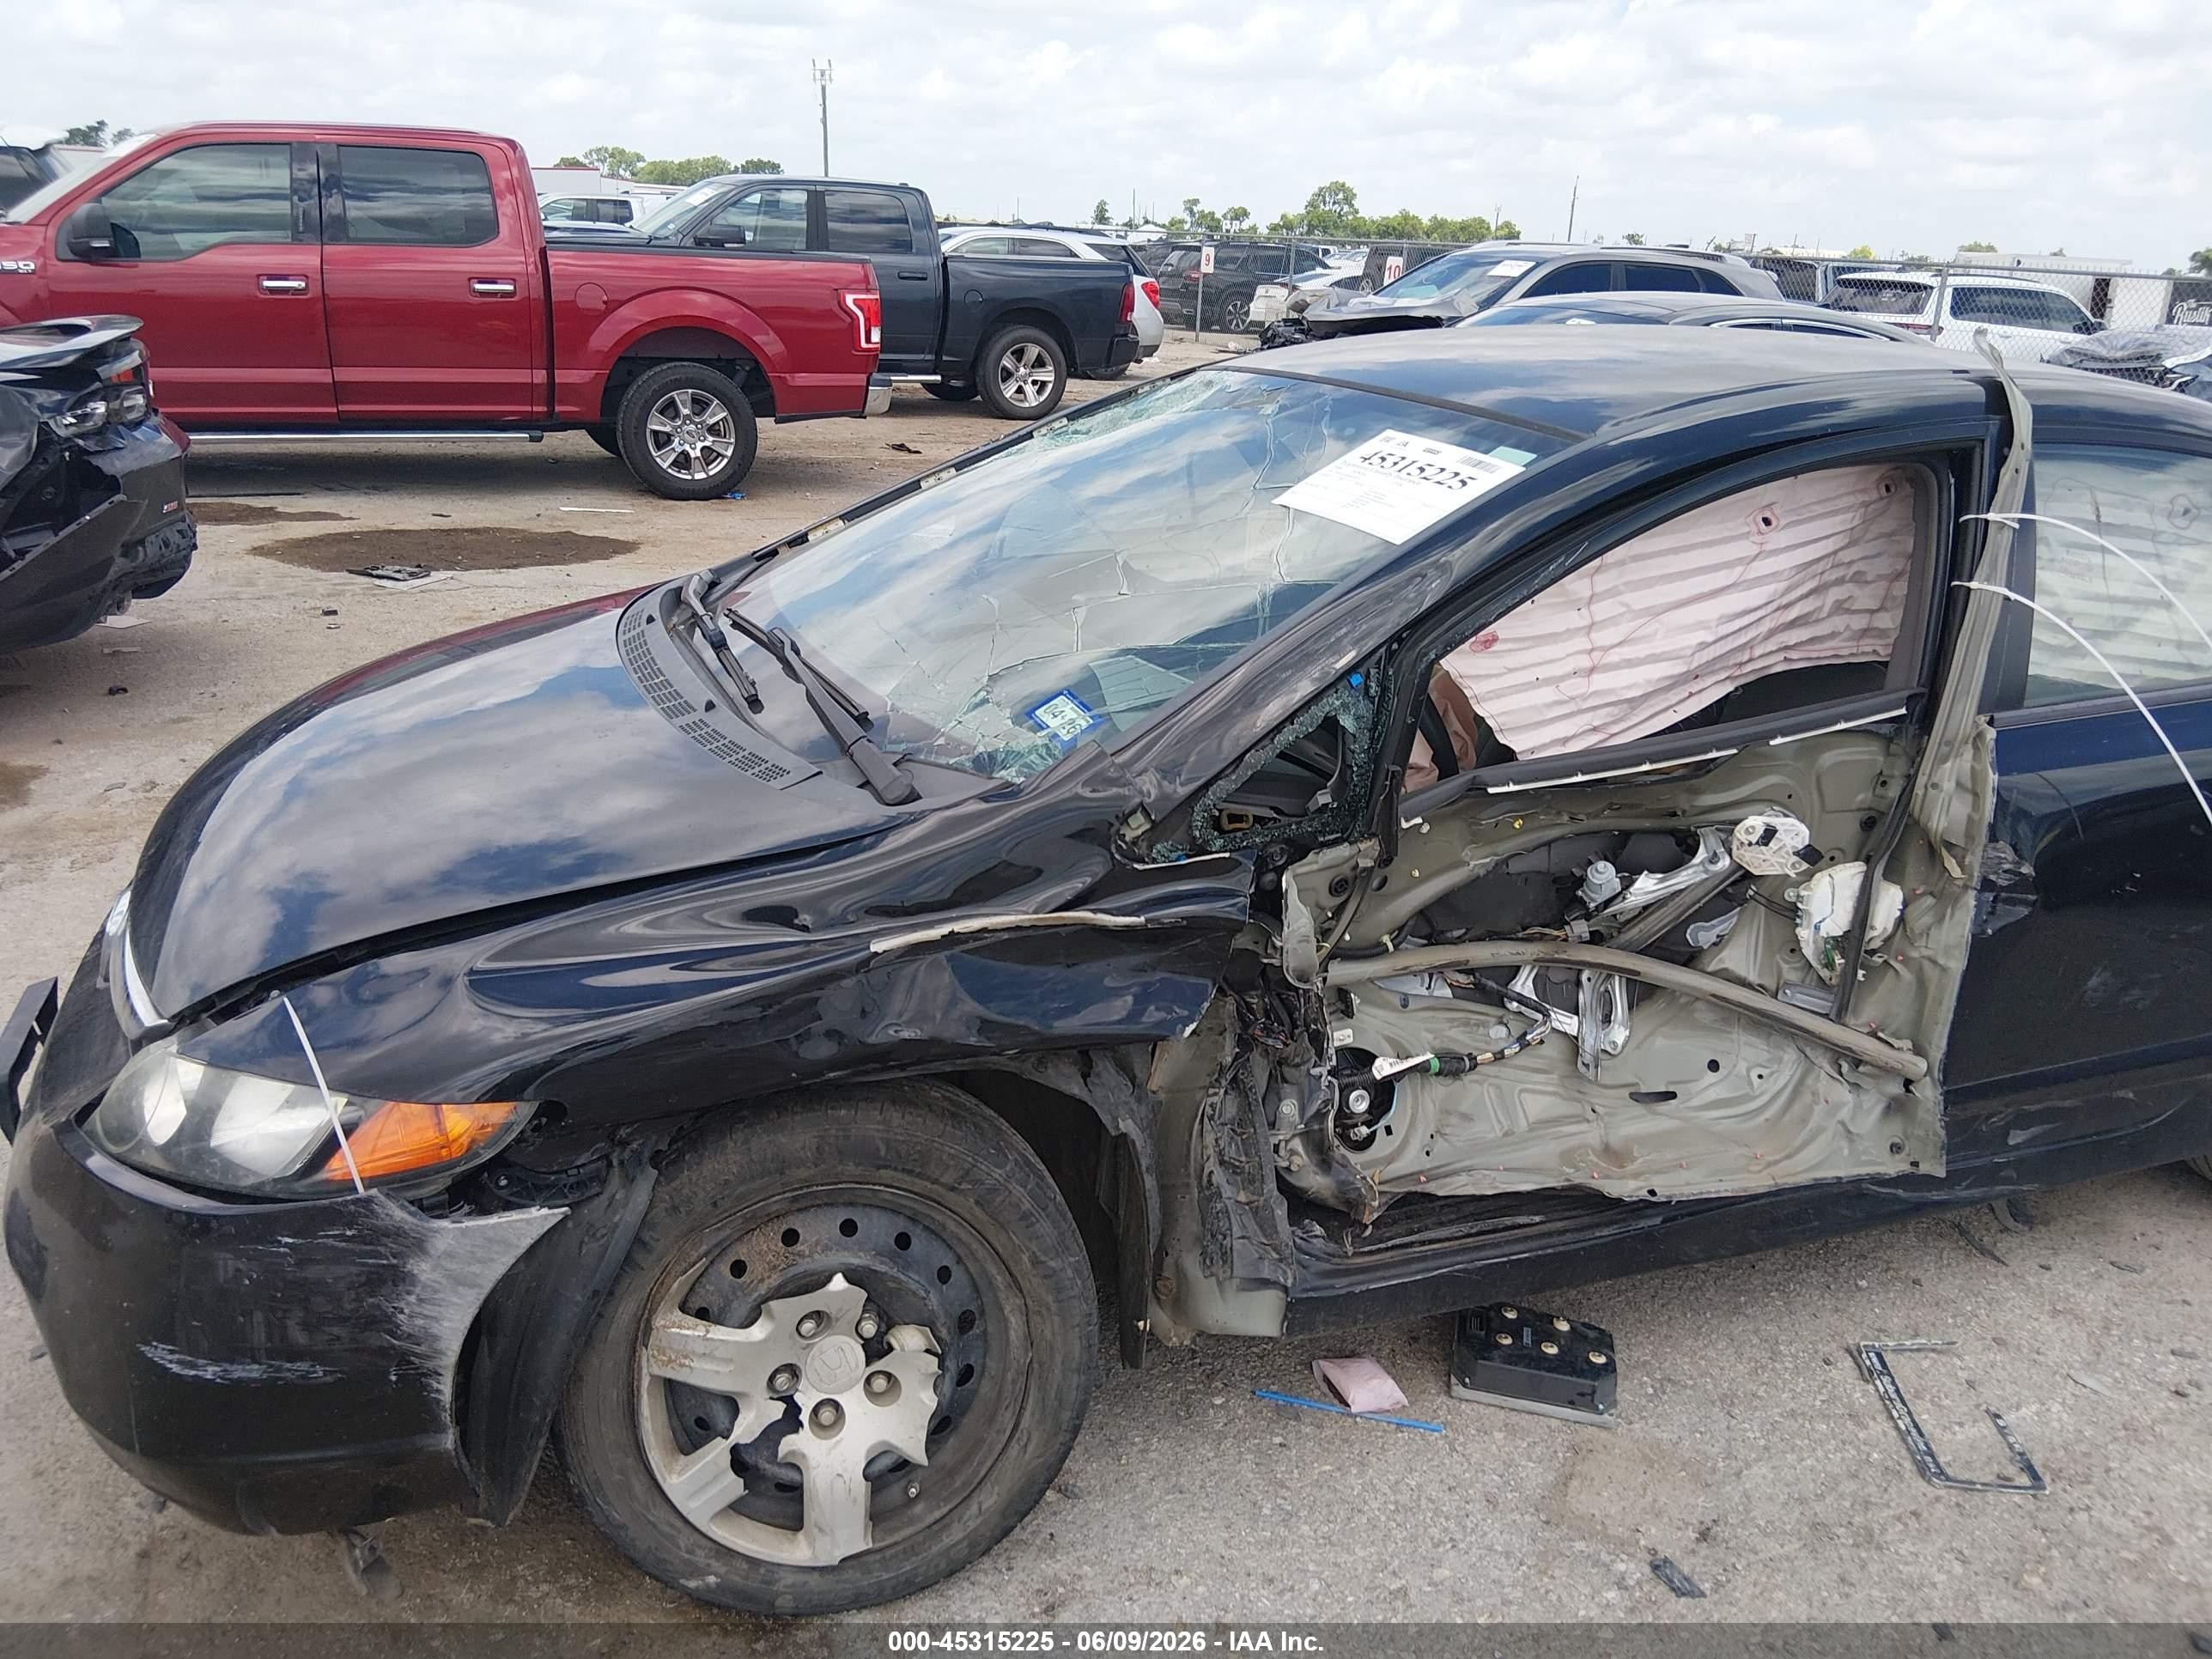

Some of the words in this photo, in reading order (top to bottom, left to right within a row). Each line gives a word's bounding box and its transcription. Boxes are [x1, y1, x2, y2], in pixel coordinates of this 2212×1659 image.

[1205, 253, 1211, 266] 9
[1387, 264, 1401, 279] 10
[1359, 450, 1478, 490] 45315225
